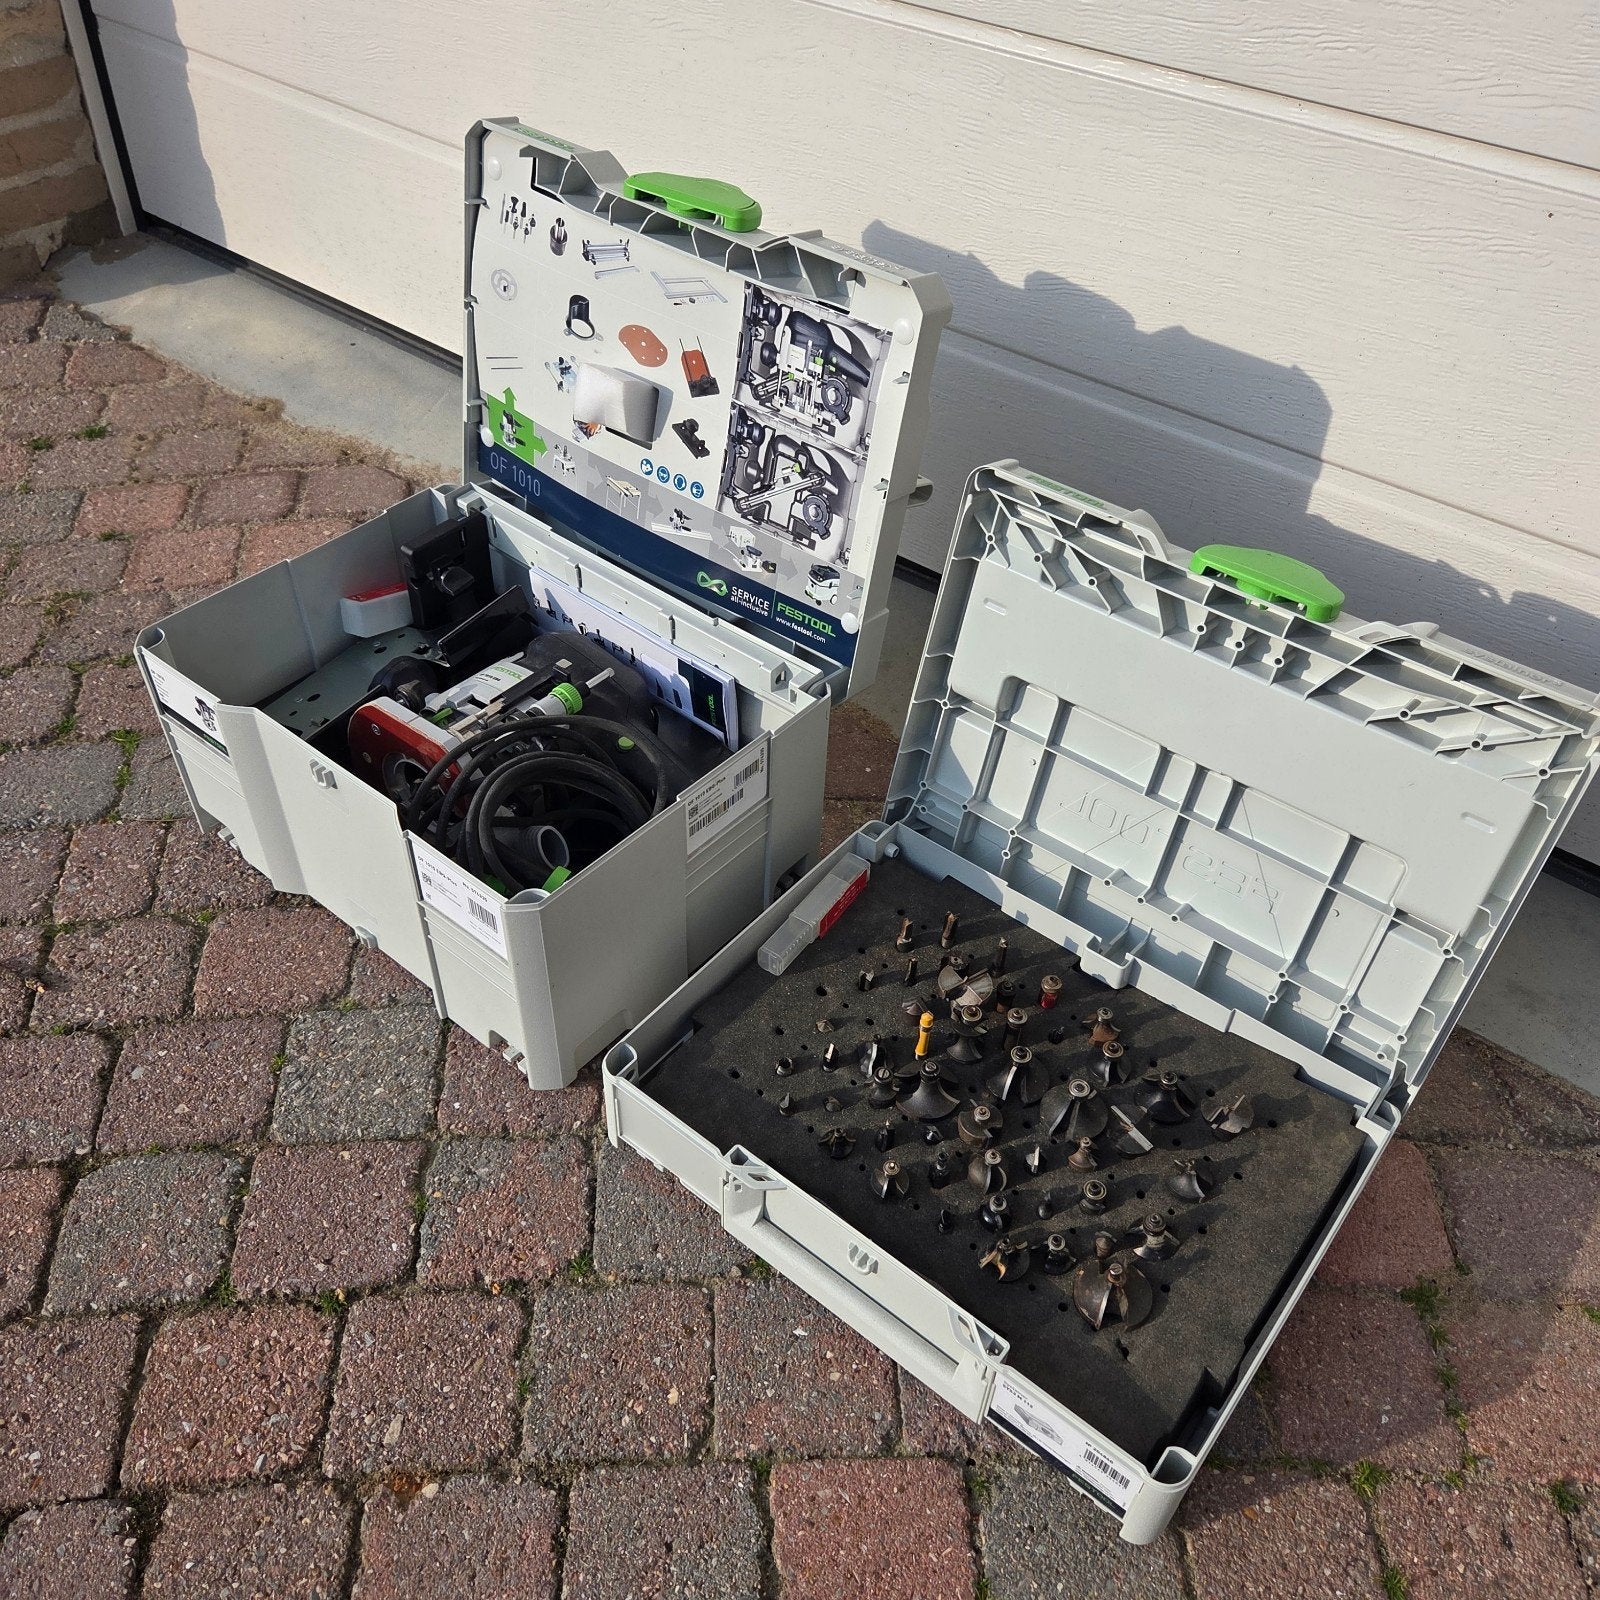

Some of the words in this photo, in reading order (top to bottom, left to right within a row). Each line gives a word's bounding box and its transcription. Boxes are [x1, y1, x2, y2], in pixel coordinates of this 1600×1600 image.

[490, 451, 508, 474] OF
[512, 465, 541, 497] 1010
[730, 594, 769, 617] all-inclusive
[731, 586, 770, 609] SERVICE
[775, 616, 826, 644] www.festool.com
[777, 602, 836, 638] FESTOOL
